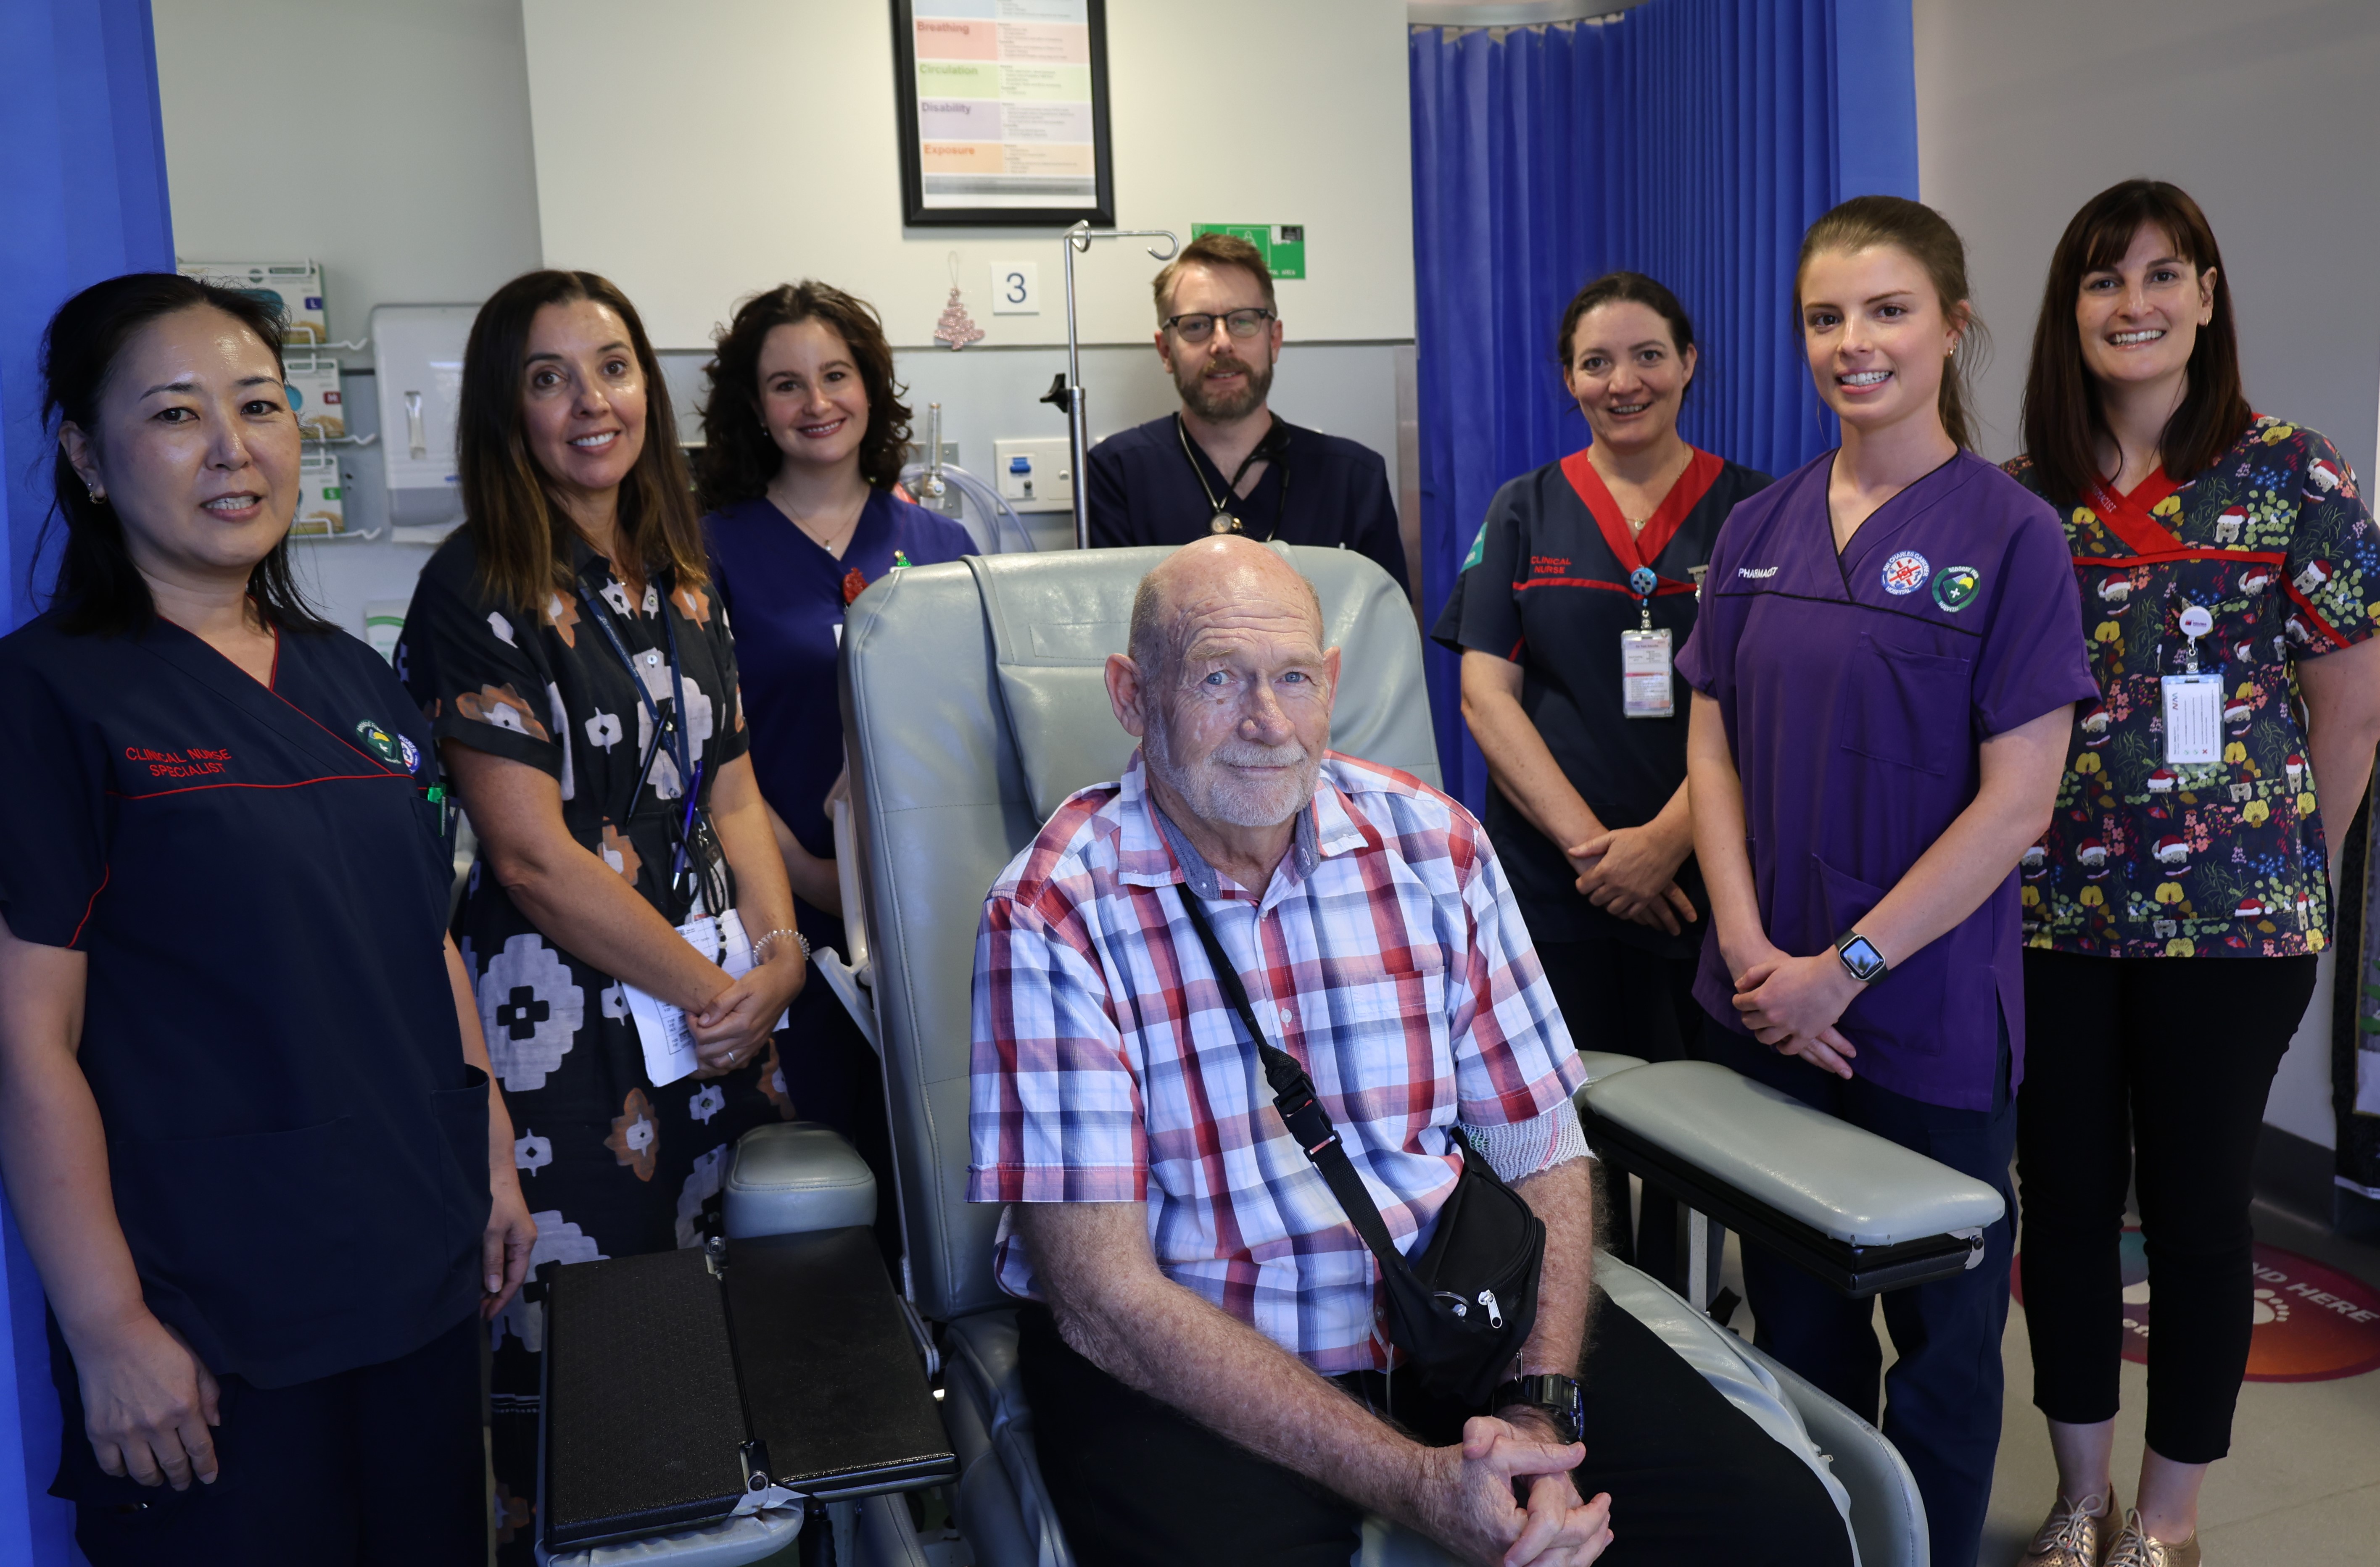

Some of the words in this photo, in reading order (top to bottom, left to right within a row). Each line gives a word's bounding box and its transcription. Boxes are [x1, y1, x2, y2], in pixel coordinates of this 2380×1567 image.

[917, 21, 969, 34] Breathing
[919, 64, 978, 75] Circulation
[921, 102, 971, 114] Disability
[924, 144, 975, 157] Exposure
[1006, 272, 1027, 303] 3
[1531, 556, 1571, 565] CLINICAL
[1889, 551, 1914, 563] CHARLES
[1914, 553, 1929, 577] GAIRDNER
[1534, 565, 1565, 574] NURSE
[1970, 569, 1979, 580] PAR
[1886, 586, 1911, 595] HOSPITAL
[1938, 600, 1959, 612] HOSPITAL
[398, 734, 417, 753] IRDNER
[126, 747, 187, 763] CLINICAL
[187, 748, 232, 761] NURSE
[149, 762, 226, 778] SPECIALIST
[2285, 1283, 2380, 1323] HERE
